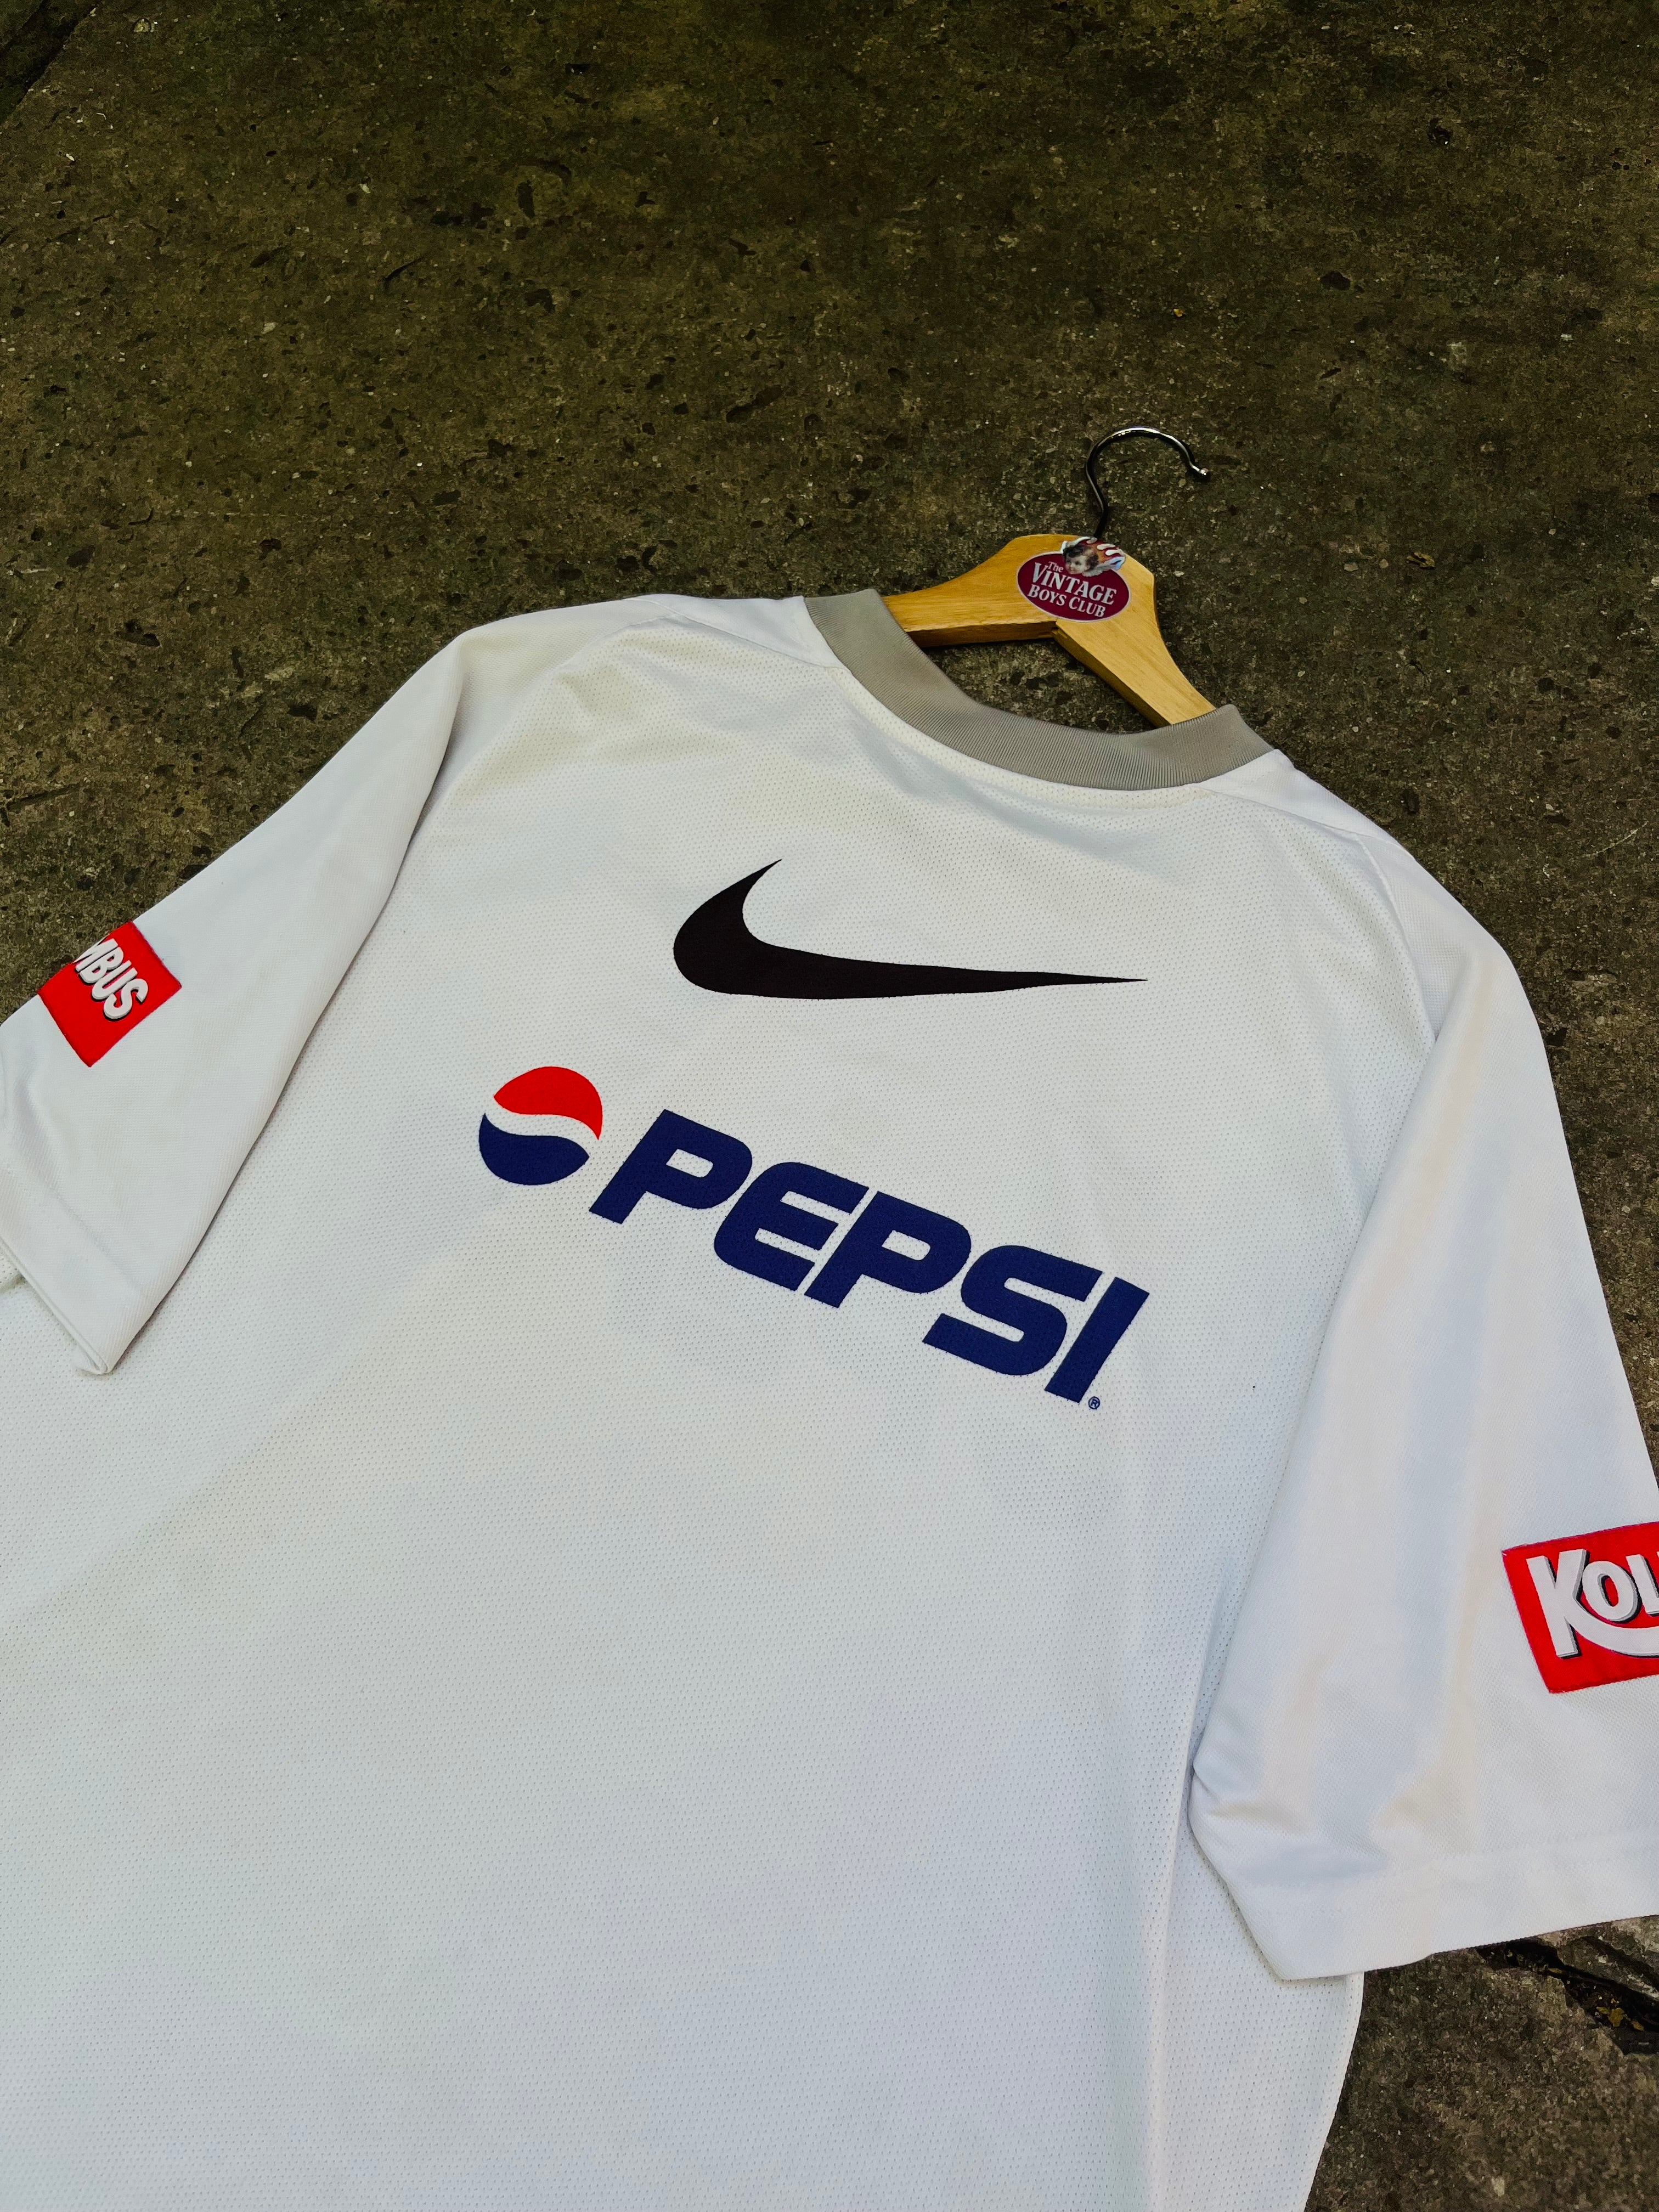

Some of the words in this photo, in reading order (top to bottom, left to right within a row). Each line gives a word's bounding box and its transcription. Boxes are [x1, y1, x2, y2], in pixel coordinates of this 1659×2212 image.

[1032, 562, 1117, 605] VINTAGE
[1047, 561, 1064, 573] The
[1028, 584, 1067, 606] BOYS
[1069, 596, 1106, 618] CLUB
[589, 1109, 1150, 1404] PEPSI
[1525, 1548, 1659, 1659] KOL
